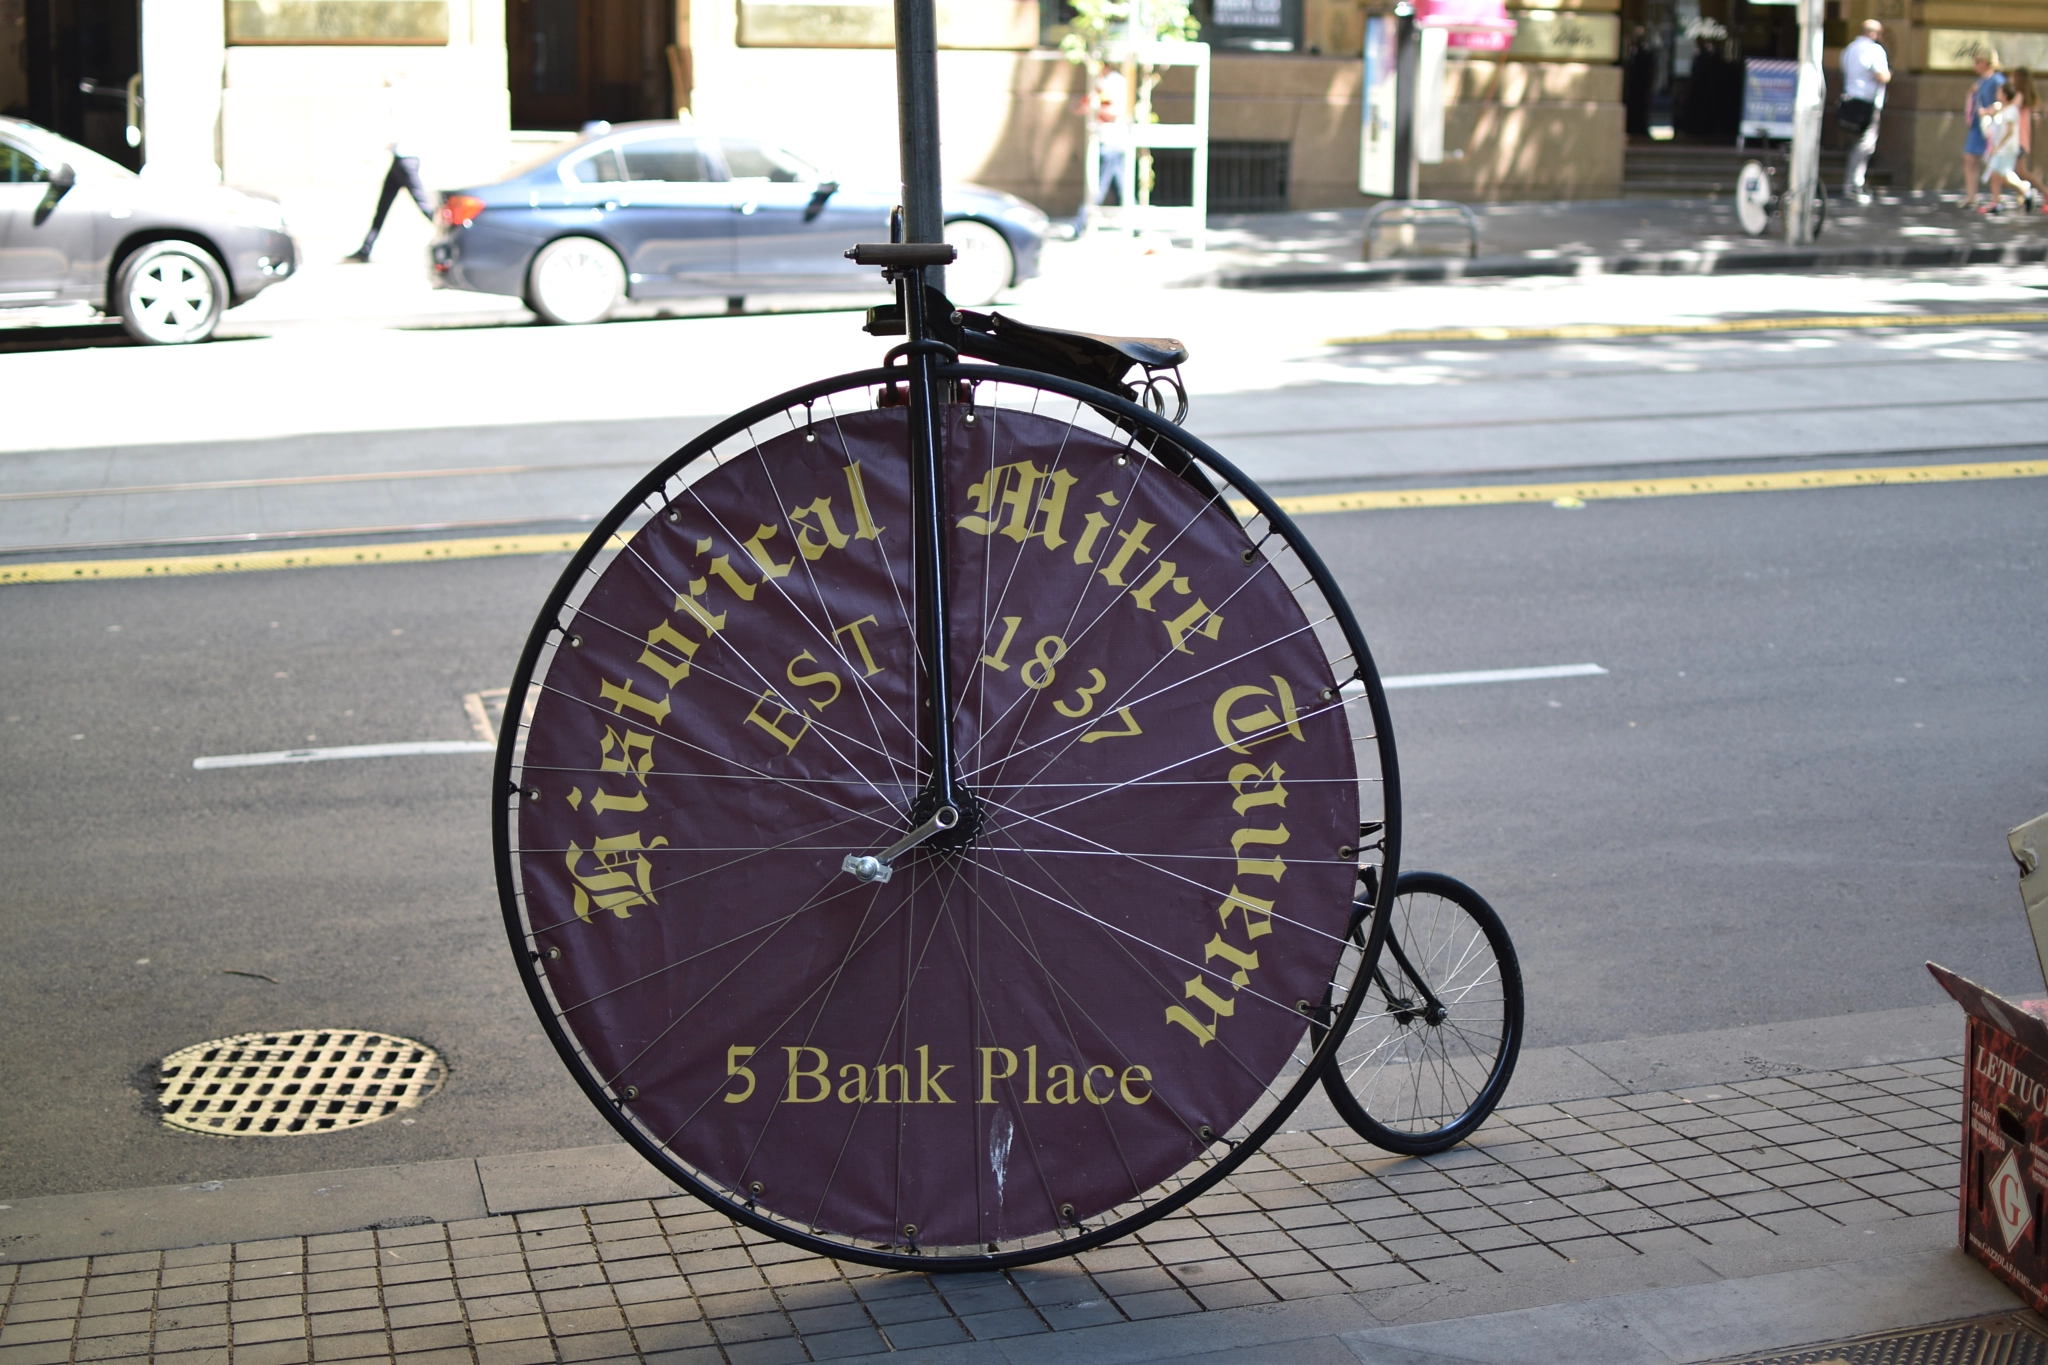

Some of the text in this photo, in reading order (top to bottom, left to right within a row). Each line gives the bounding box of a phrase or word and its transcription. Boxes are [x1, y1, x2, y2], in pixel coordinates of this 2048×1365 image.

[743, 614, 1142, 755] EST 1837
[566, 457, 1306, 1047] Historical Mitre Tavern
[723, 1044, 1153, 1105] 5 Bank Place
[1972, 1101, 1992, 1123] CLASS
[1999, 1173, 2021, 1227] G
